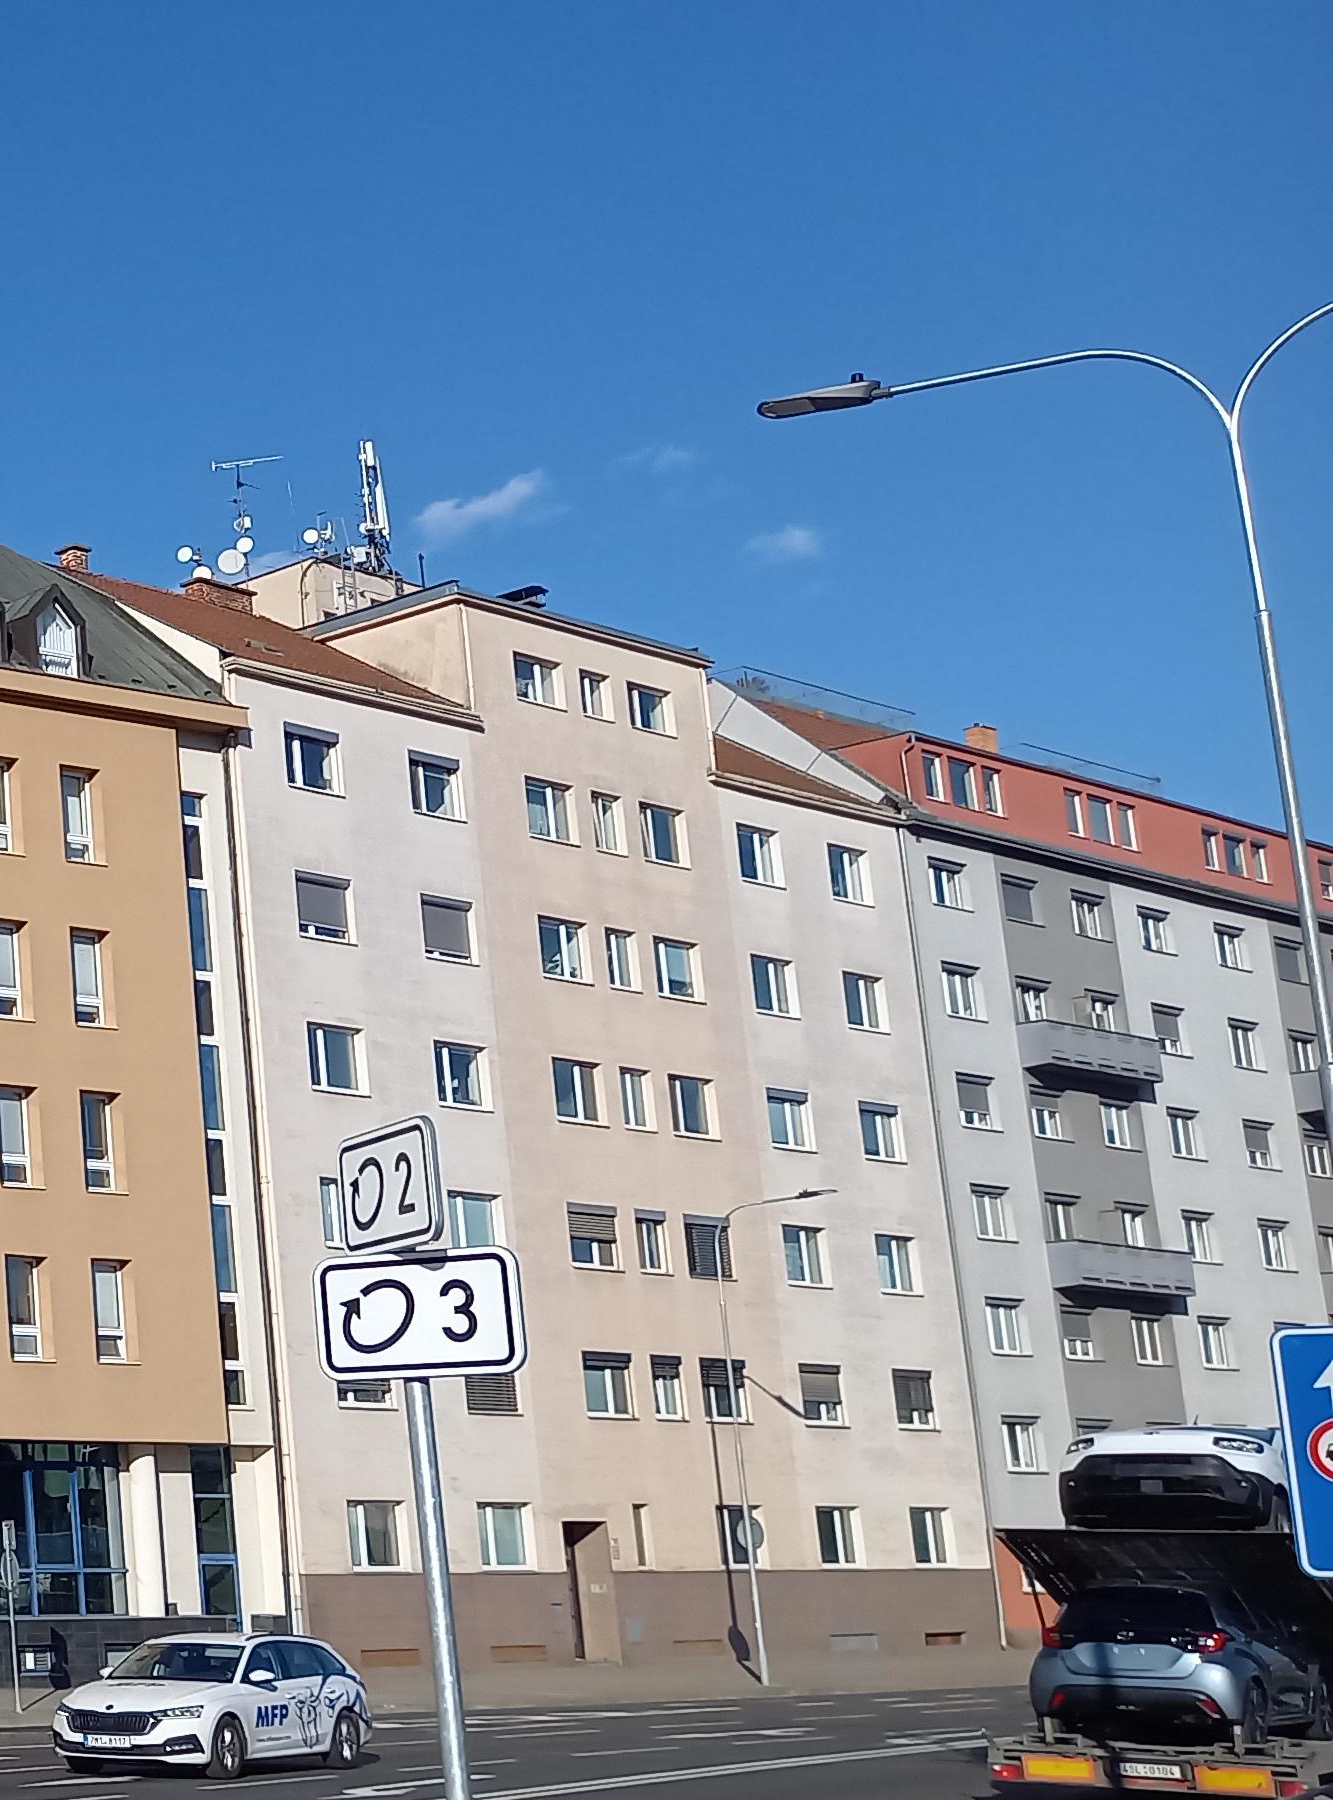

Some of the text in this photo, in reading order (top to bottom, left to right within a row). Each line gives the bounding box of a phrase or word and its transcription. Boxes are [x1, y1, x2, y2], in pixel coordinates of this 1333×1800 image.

[395, 1152, 415, 1215] 2
[440, 1279, 477, 1342] 3
[255, 1704, 289, 1728] MFP
